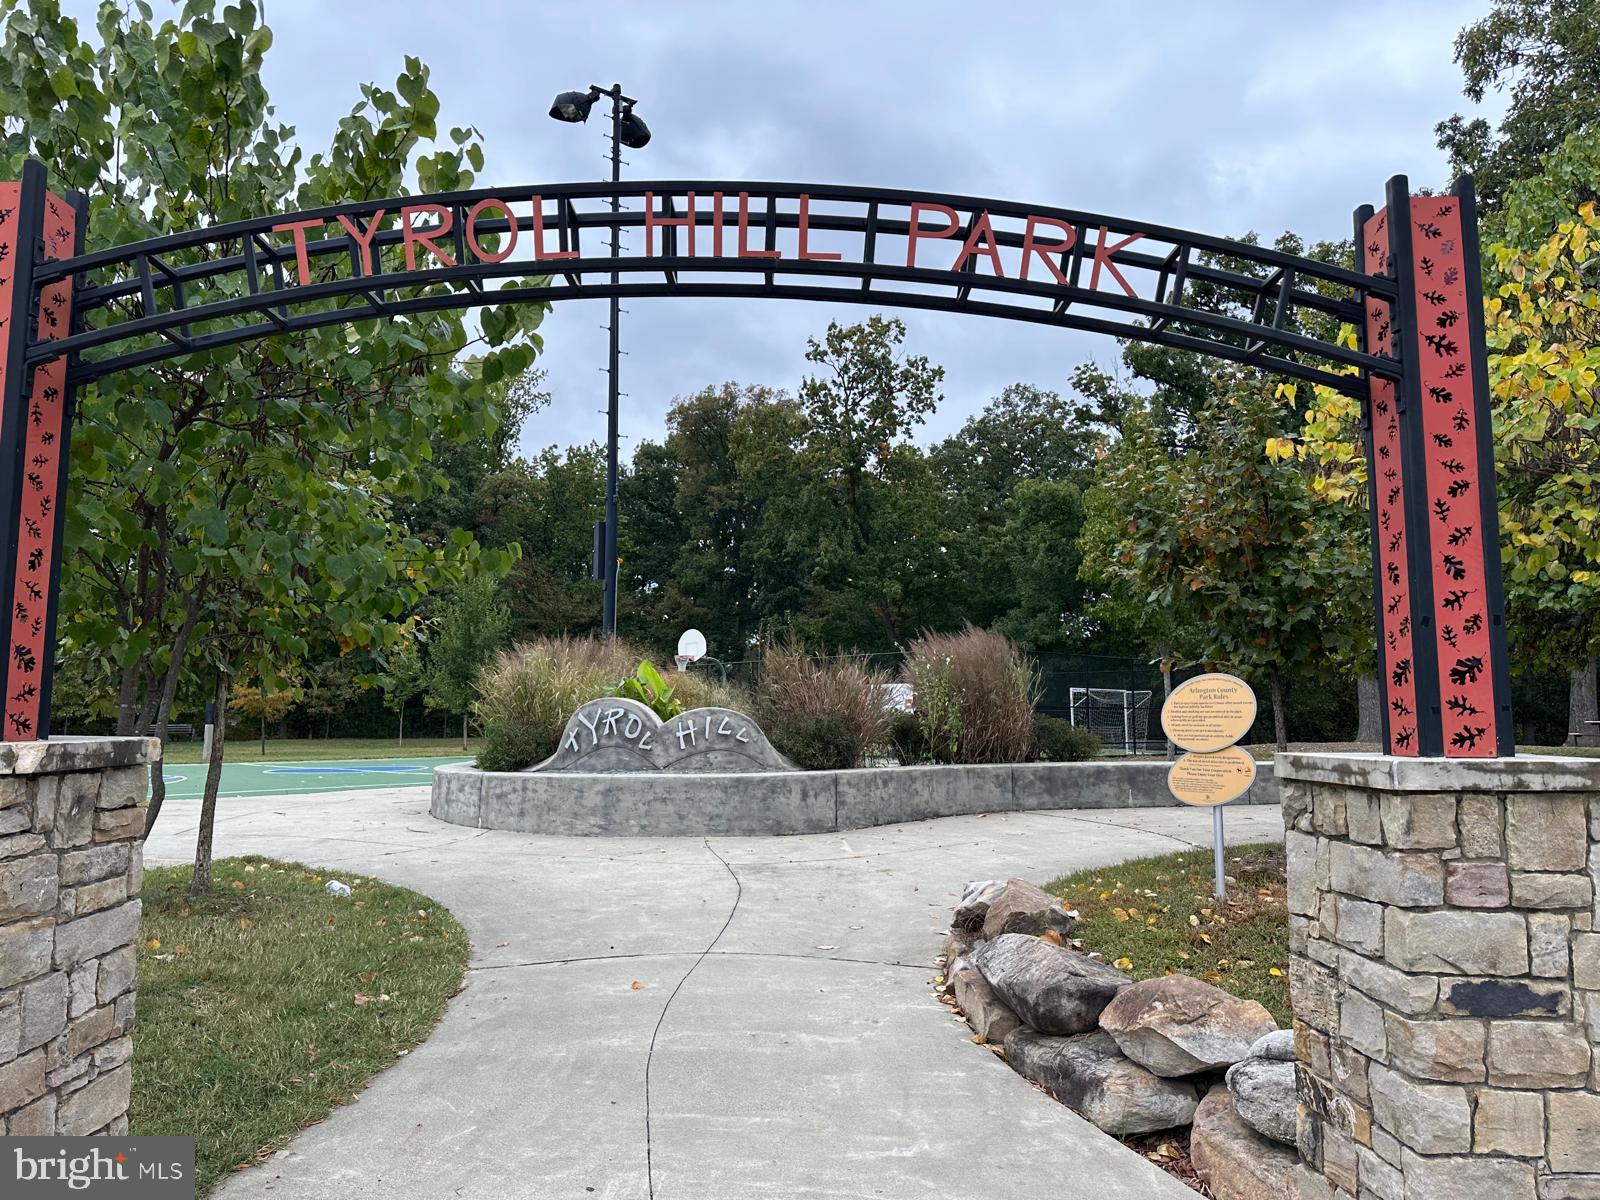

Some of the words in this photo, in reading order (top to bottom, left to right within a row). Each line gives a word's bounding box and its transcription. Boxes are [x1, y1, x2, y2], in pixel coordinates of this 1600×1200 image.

[272, 194, 579, 286] TYROL
[645, 191, 842, 260] HILL
[906, 201, 1146, 298] PARK
[564, 707, 653, 753] TYROL
[676, 715, 750, 750] HILL
